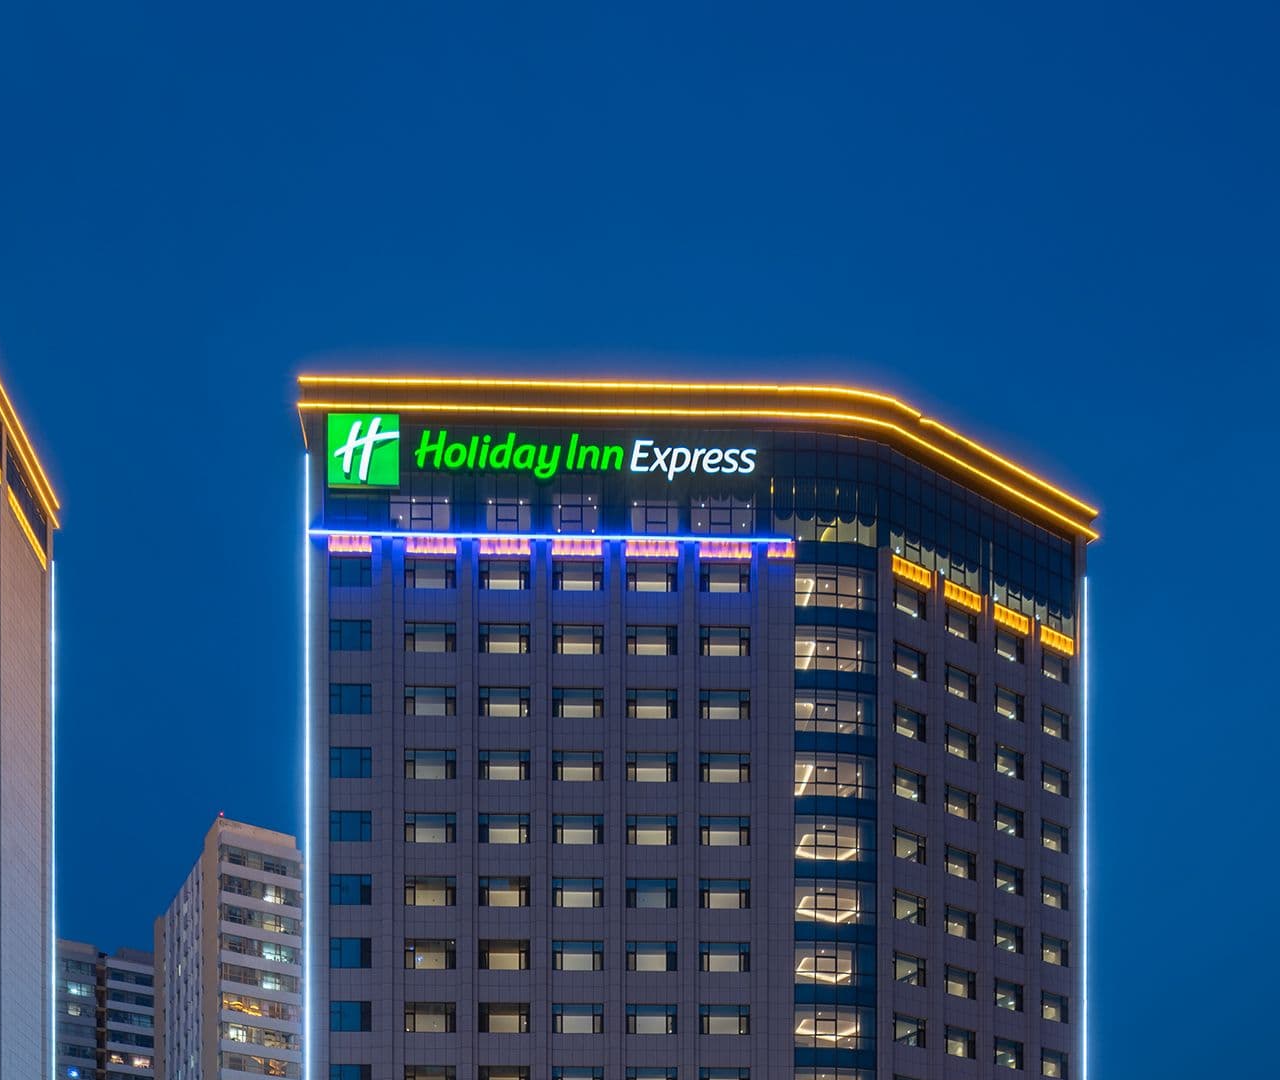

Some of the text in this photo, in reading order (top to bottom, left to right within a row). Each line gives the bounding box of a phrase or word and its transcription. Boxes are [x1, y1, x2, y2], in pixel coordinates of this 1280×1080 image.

[415, 429, 757, 481] Holiday Inn Express
